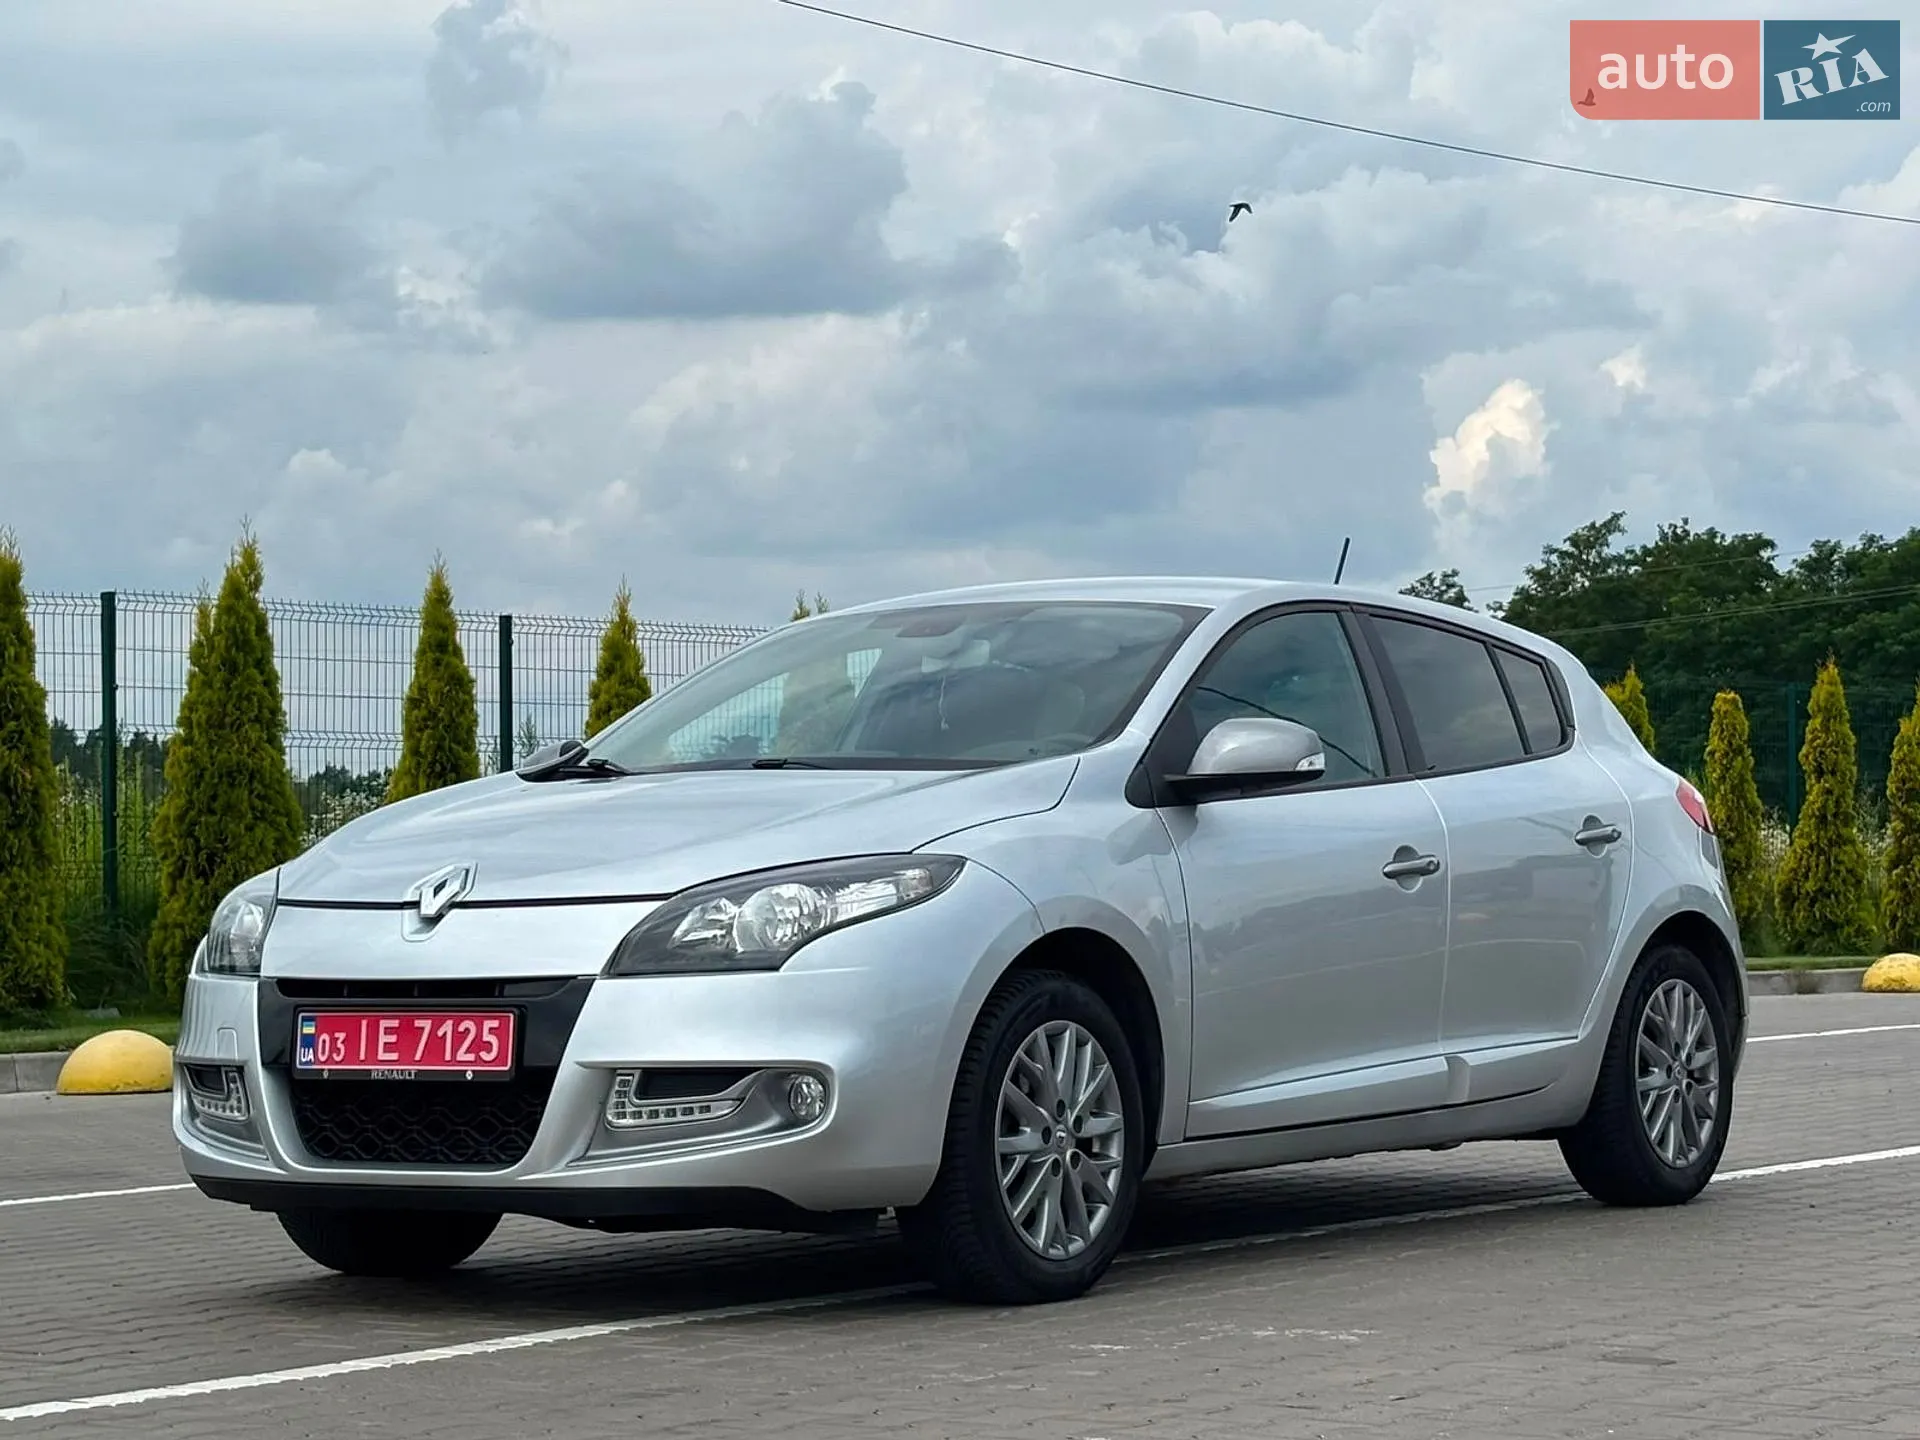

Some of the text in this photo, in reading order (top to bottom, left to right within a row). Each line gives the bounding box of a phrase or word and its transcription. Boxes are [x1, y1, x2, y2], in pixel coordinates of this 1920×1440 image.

[317, 1019, 500, 1062] 03 IE 7125
[301, 1047, 314, 1063] UA
[370, 1070, 418, 1080] RENAULT
